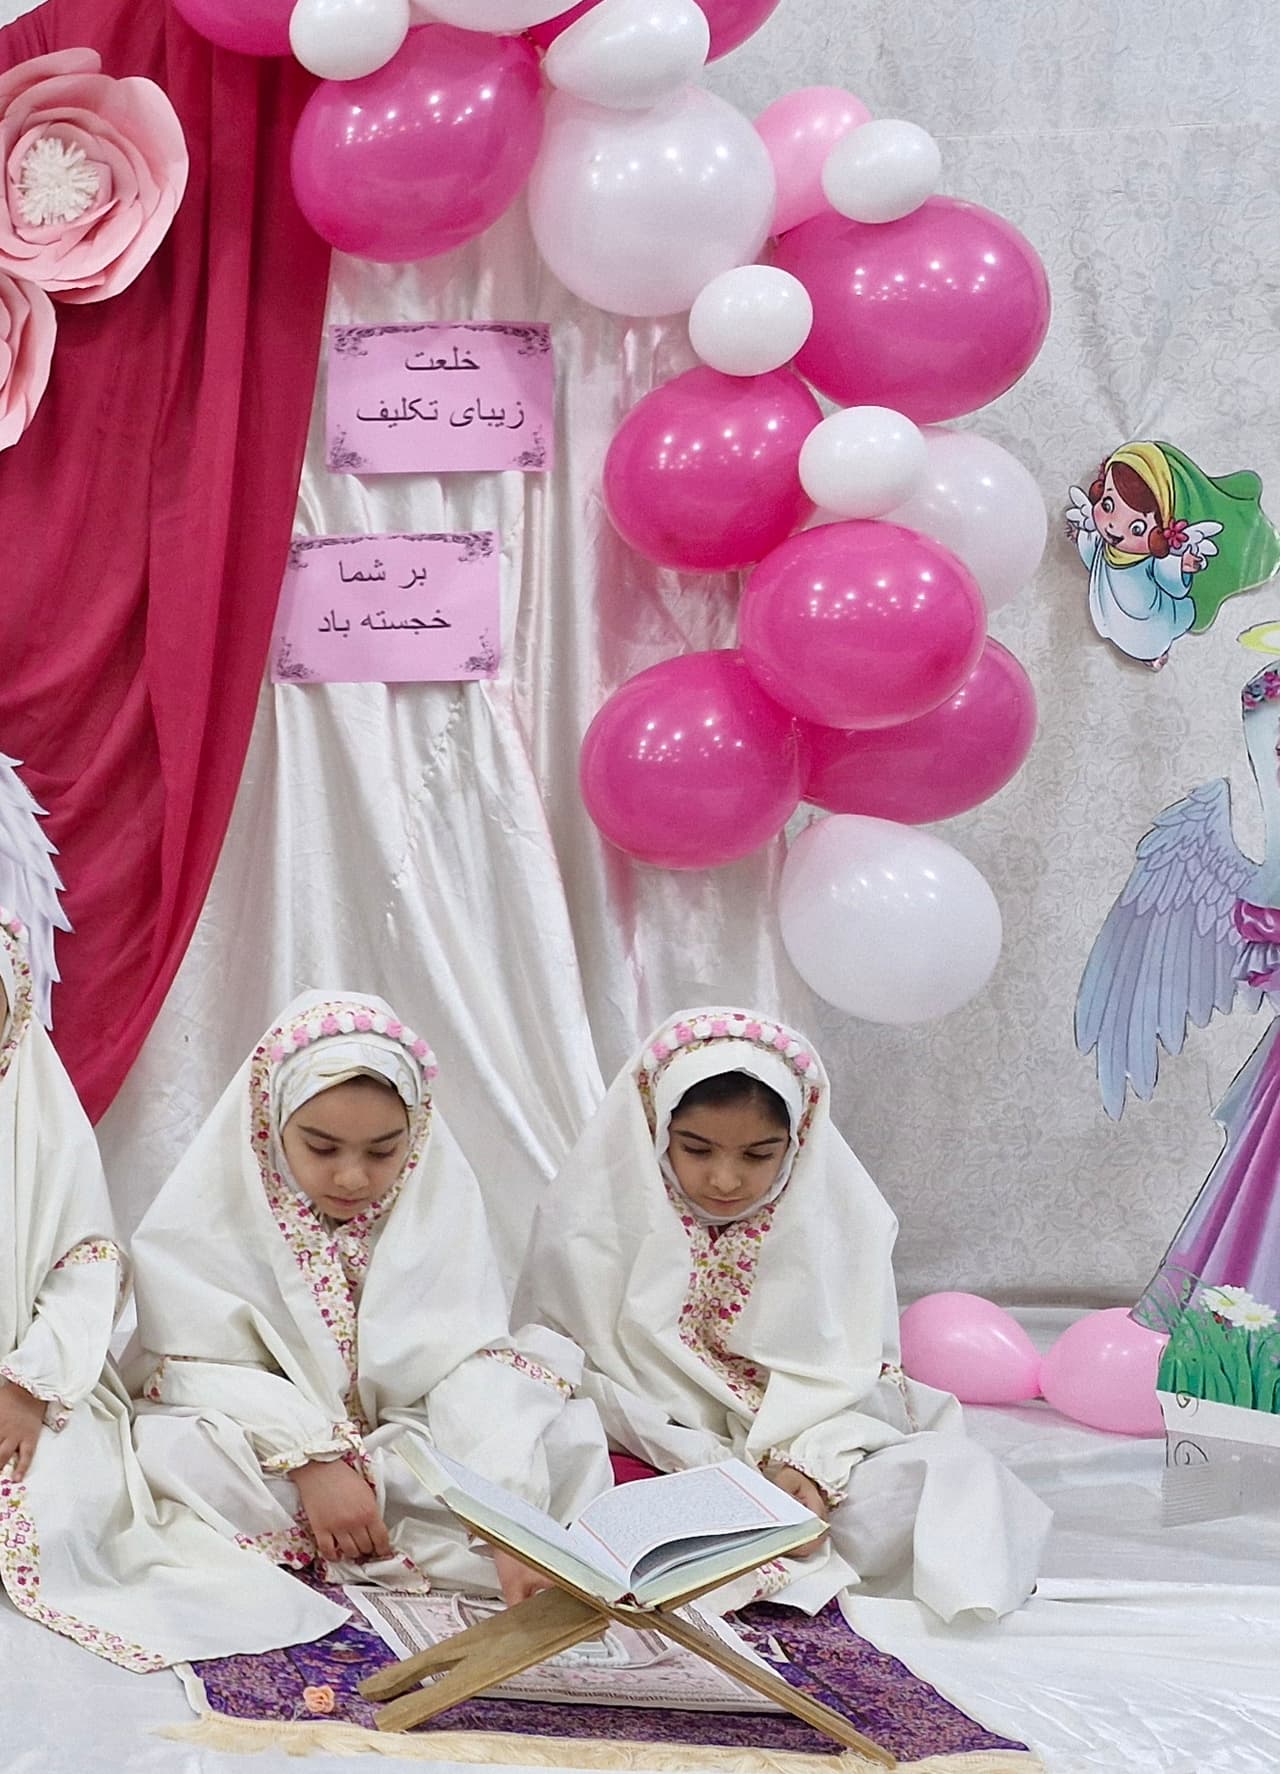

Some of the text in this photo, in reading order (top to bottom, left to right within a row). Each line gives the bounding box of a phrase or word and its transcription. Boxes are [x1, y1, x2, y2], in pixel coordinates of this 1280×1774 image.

[404, 345, 481, 371] خلعت
[356, 396, 525, 430] زیبای تکلیف
[338, 558, 427, 590] بر شما
[317, 608, 452, 638] خجسته باد
